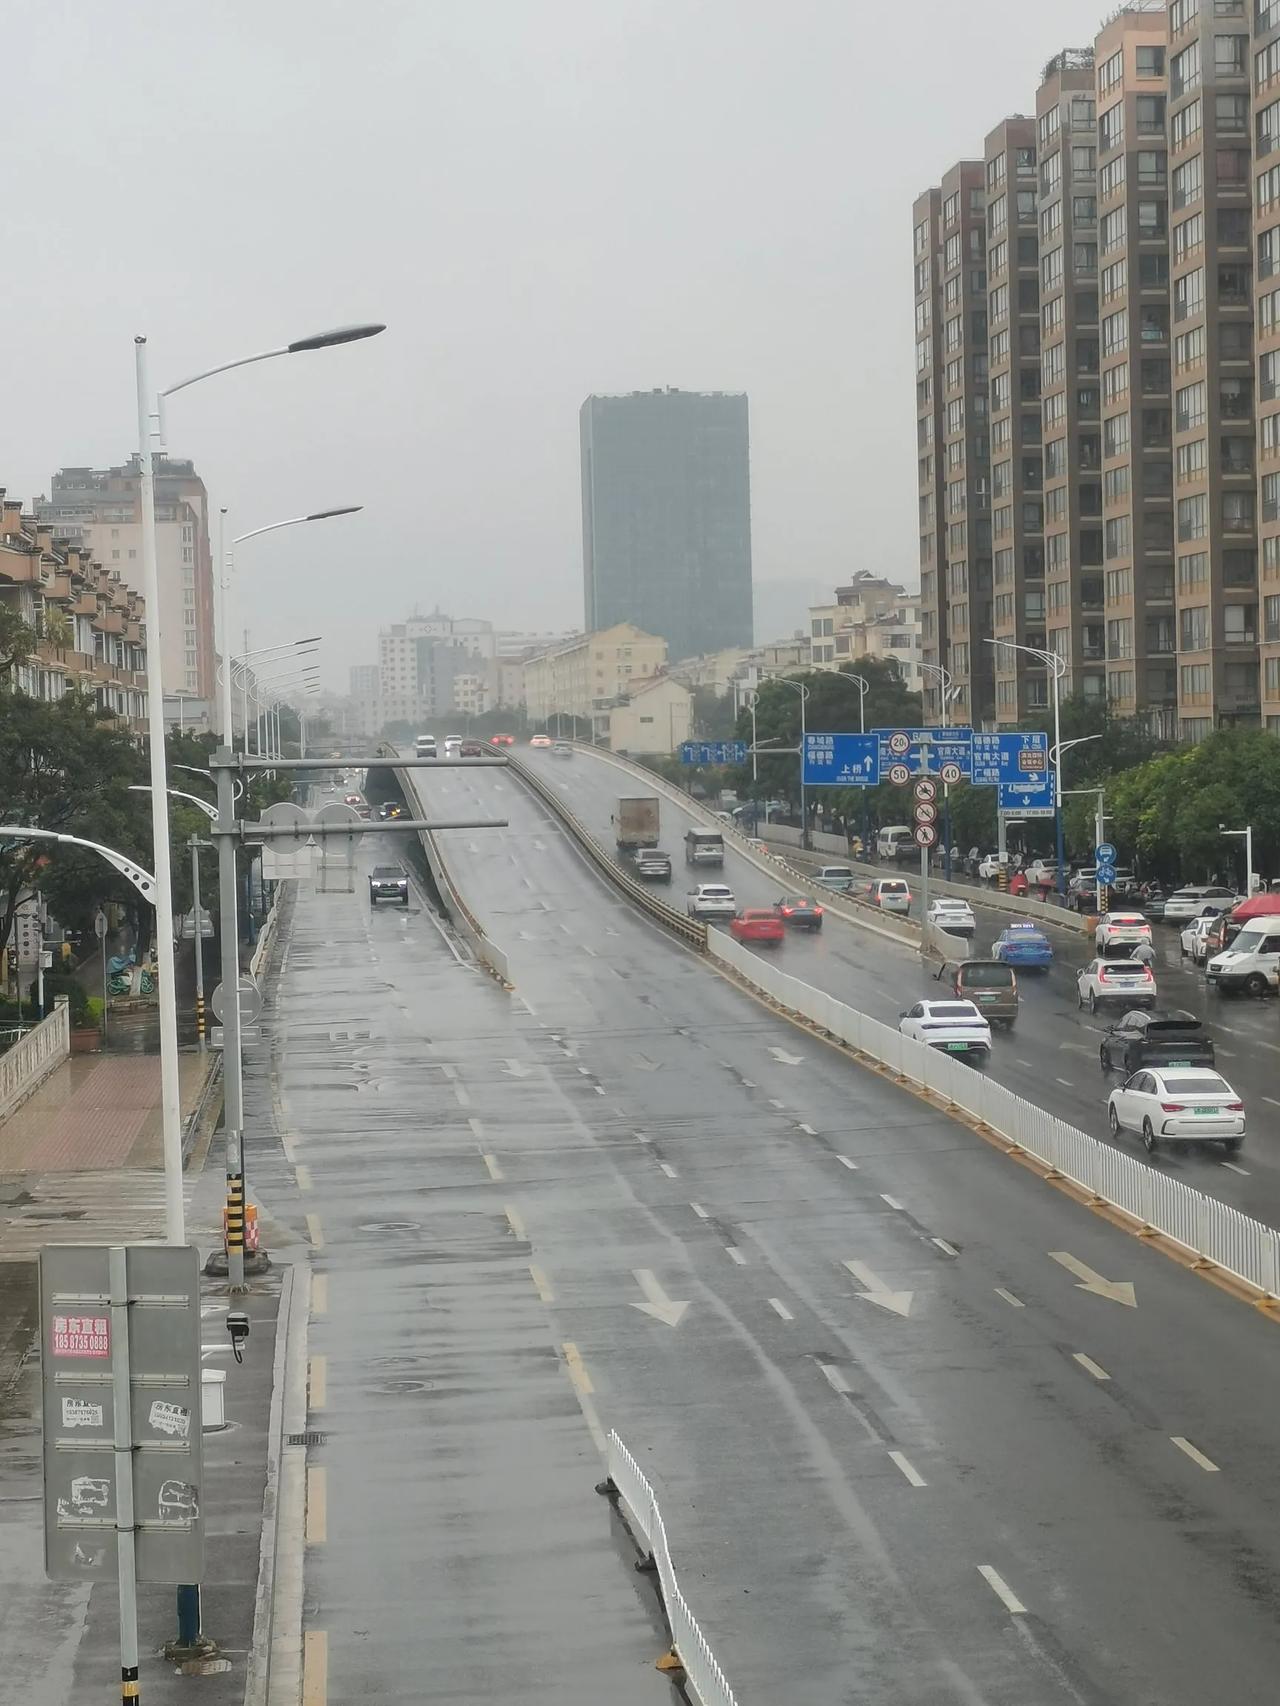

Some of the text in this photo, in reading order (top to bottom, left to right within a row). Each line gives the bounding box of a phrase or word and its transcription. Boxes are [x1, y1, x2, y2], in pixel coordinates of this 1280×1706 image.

[841, 764, 862, 774] 上桥
[893, 769, 906, 779] 50
[944, 769, 957, 779] 40
[54, 1317, 107, 1335] 房东直租
